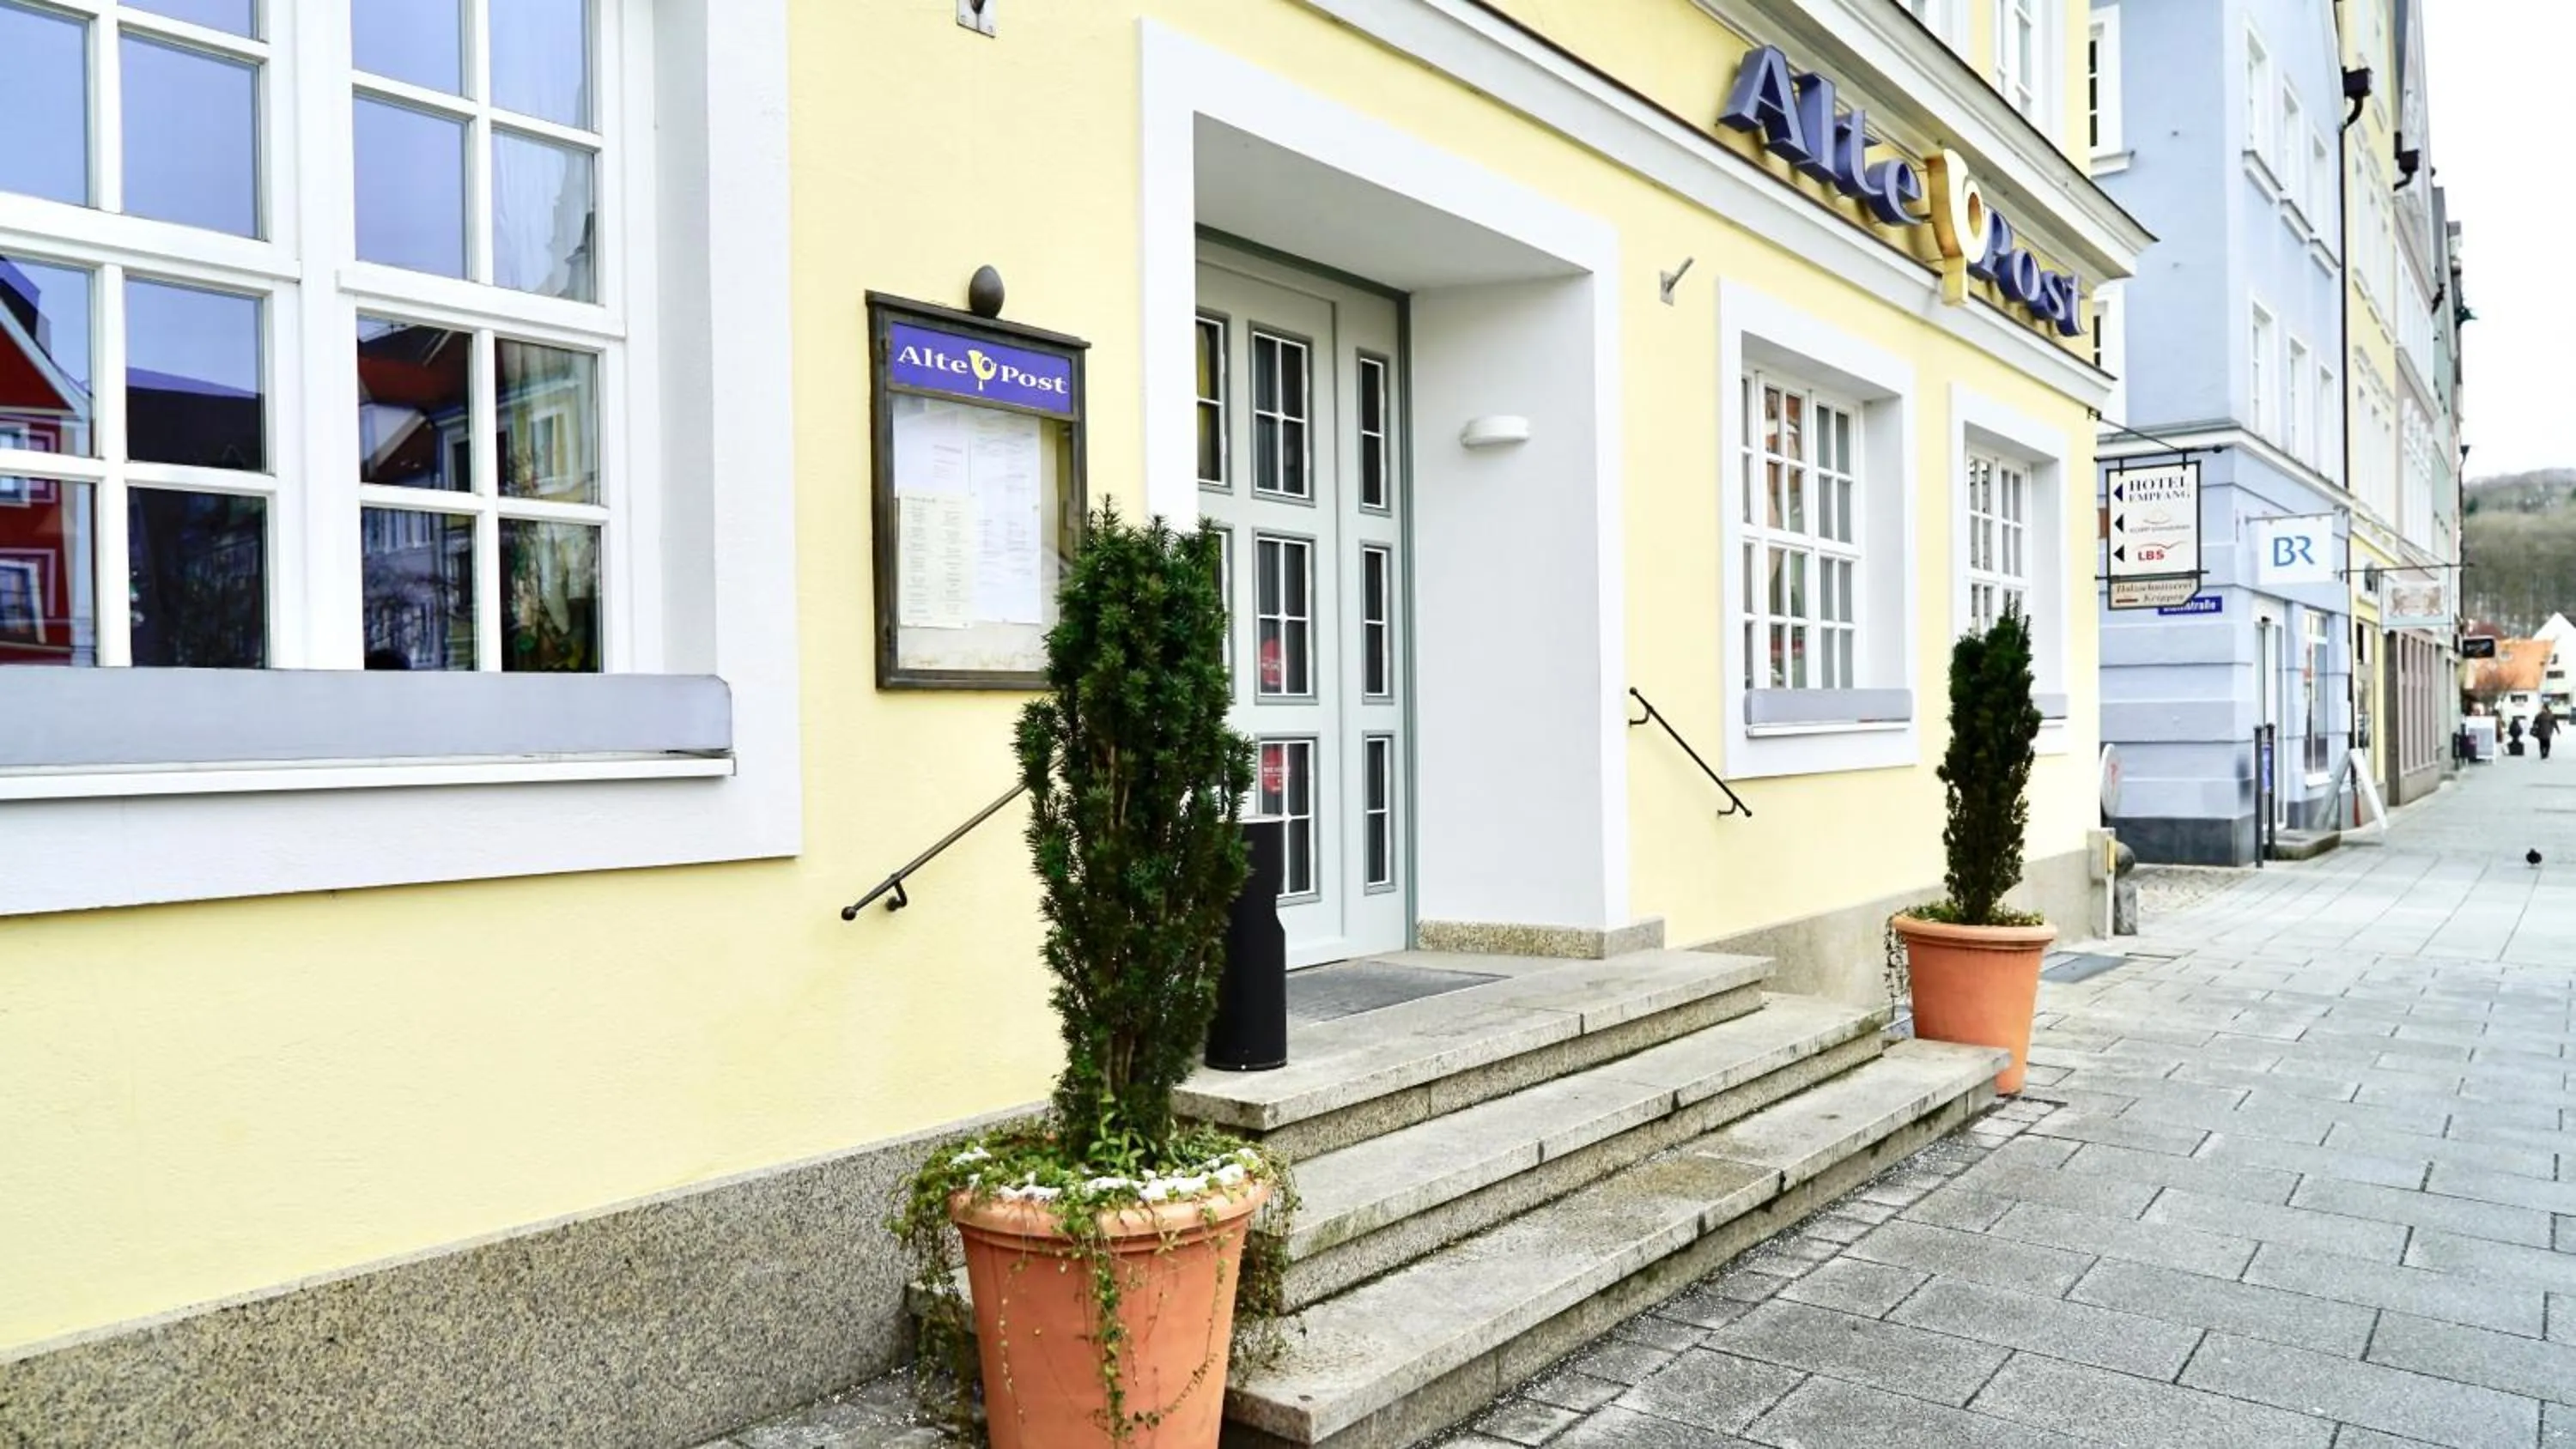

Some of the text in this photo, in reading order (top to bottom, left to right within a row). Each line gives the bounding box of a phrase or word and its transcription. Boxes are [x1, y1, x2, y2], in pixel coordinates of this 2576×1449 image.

[1717, 45, 2089, 337] Alte Post
[897, 345, 1070, 394] Alte Post
[2129, 476, 2189, 492] HOTEL
[2129, 490, 2191, 503] EMPFANG
[2138, 549, 2166, 561] LBS
[2274, 536, 2315, 567] BR
